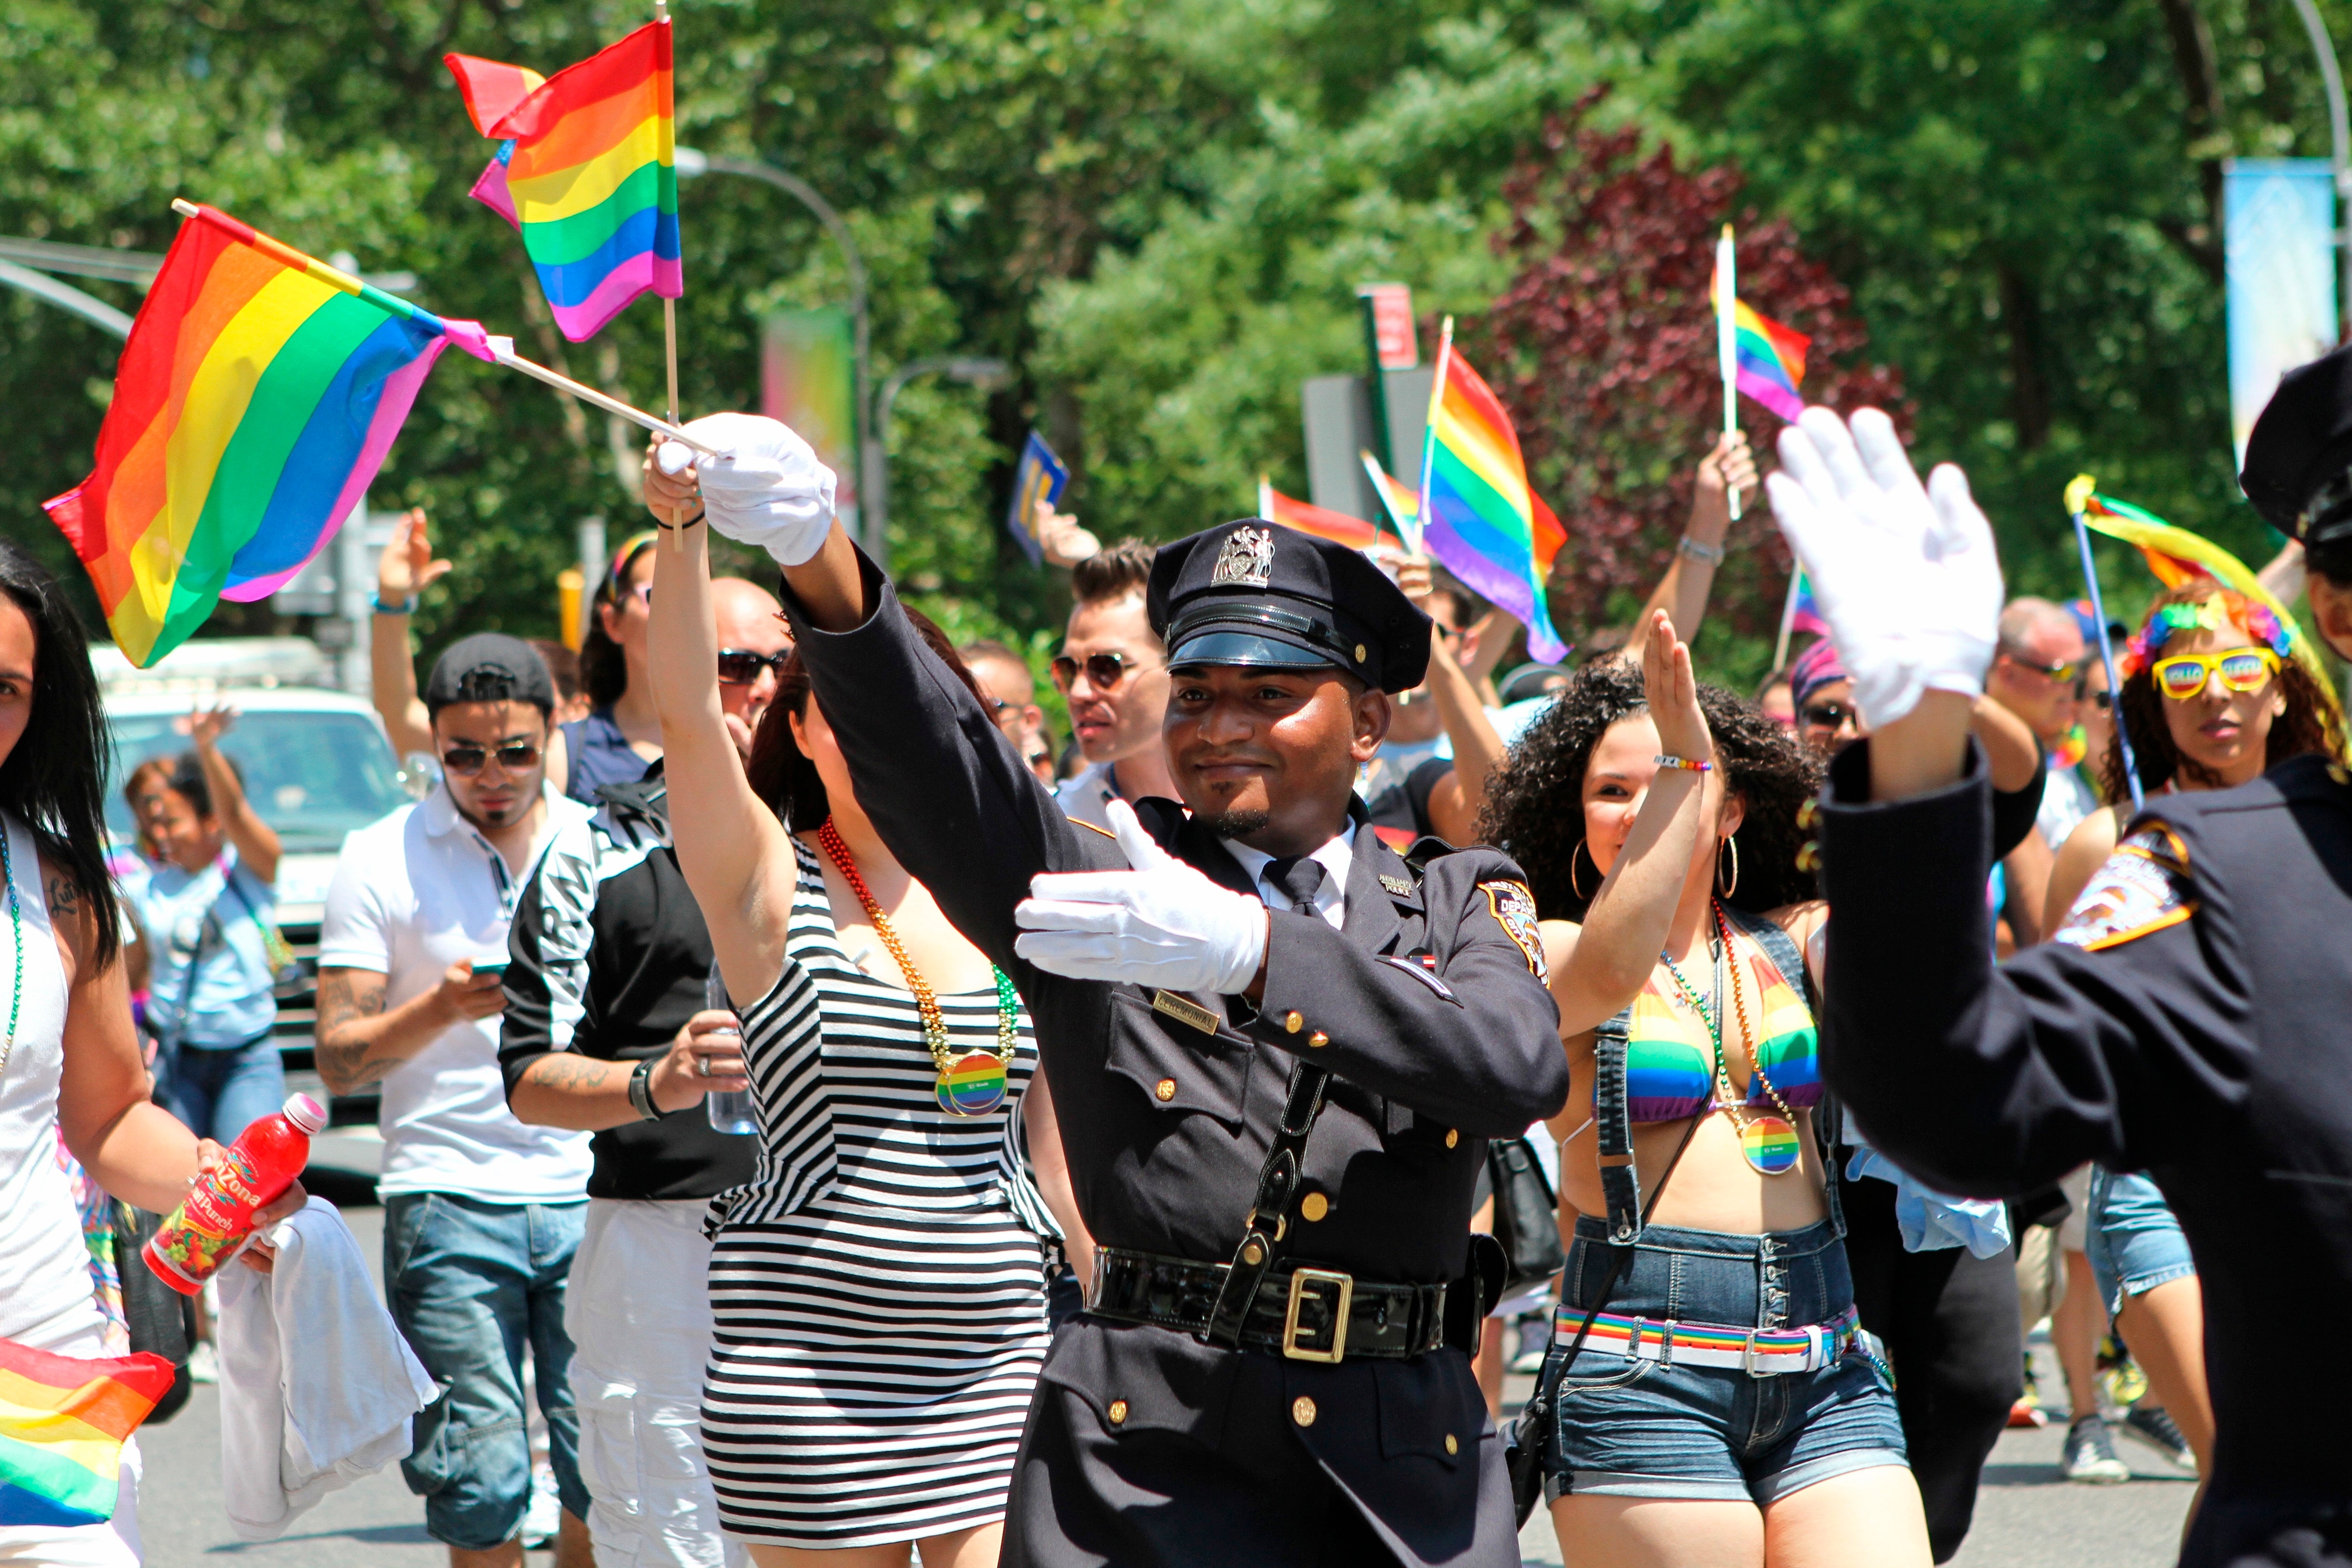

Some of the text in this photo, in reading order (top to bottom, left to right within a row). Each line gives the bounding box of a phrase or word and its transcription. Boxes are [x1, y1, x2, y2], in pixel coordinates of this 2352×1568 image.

[1385, 884, 1412, 897] POLICE
[1506, 918, 1534, 946] CITY
[1526, 945, 1538, 962] OF
[1158, 996, 1213, 1029] CEREMONIAL
[213, 1160, 262, 1207] riZona
[200, 1196, 233, 1231] Punch
